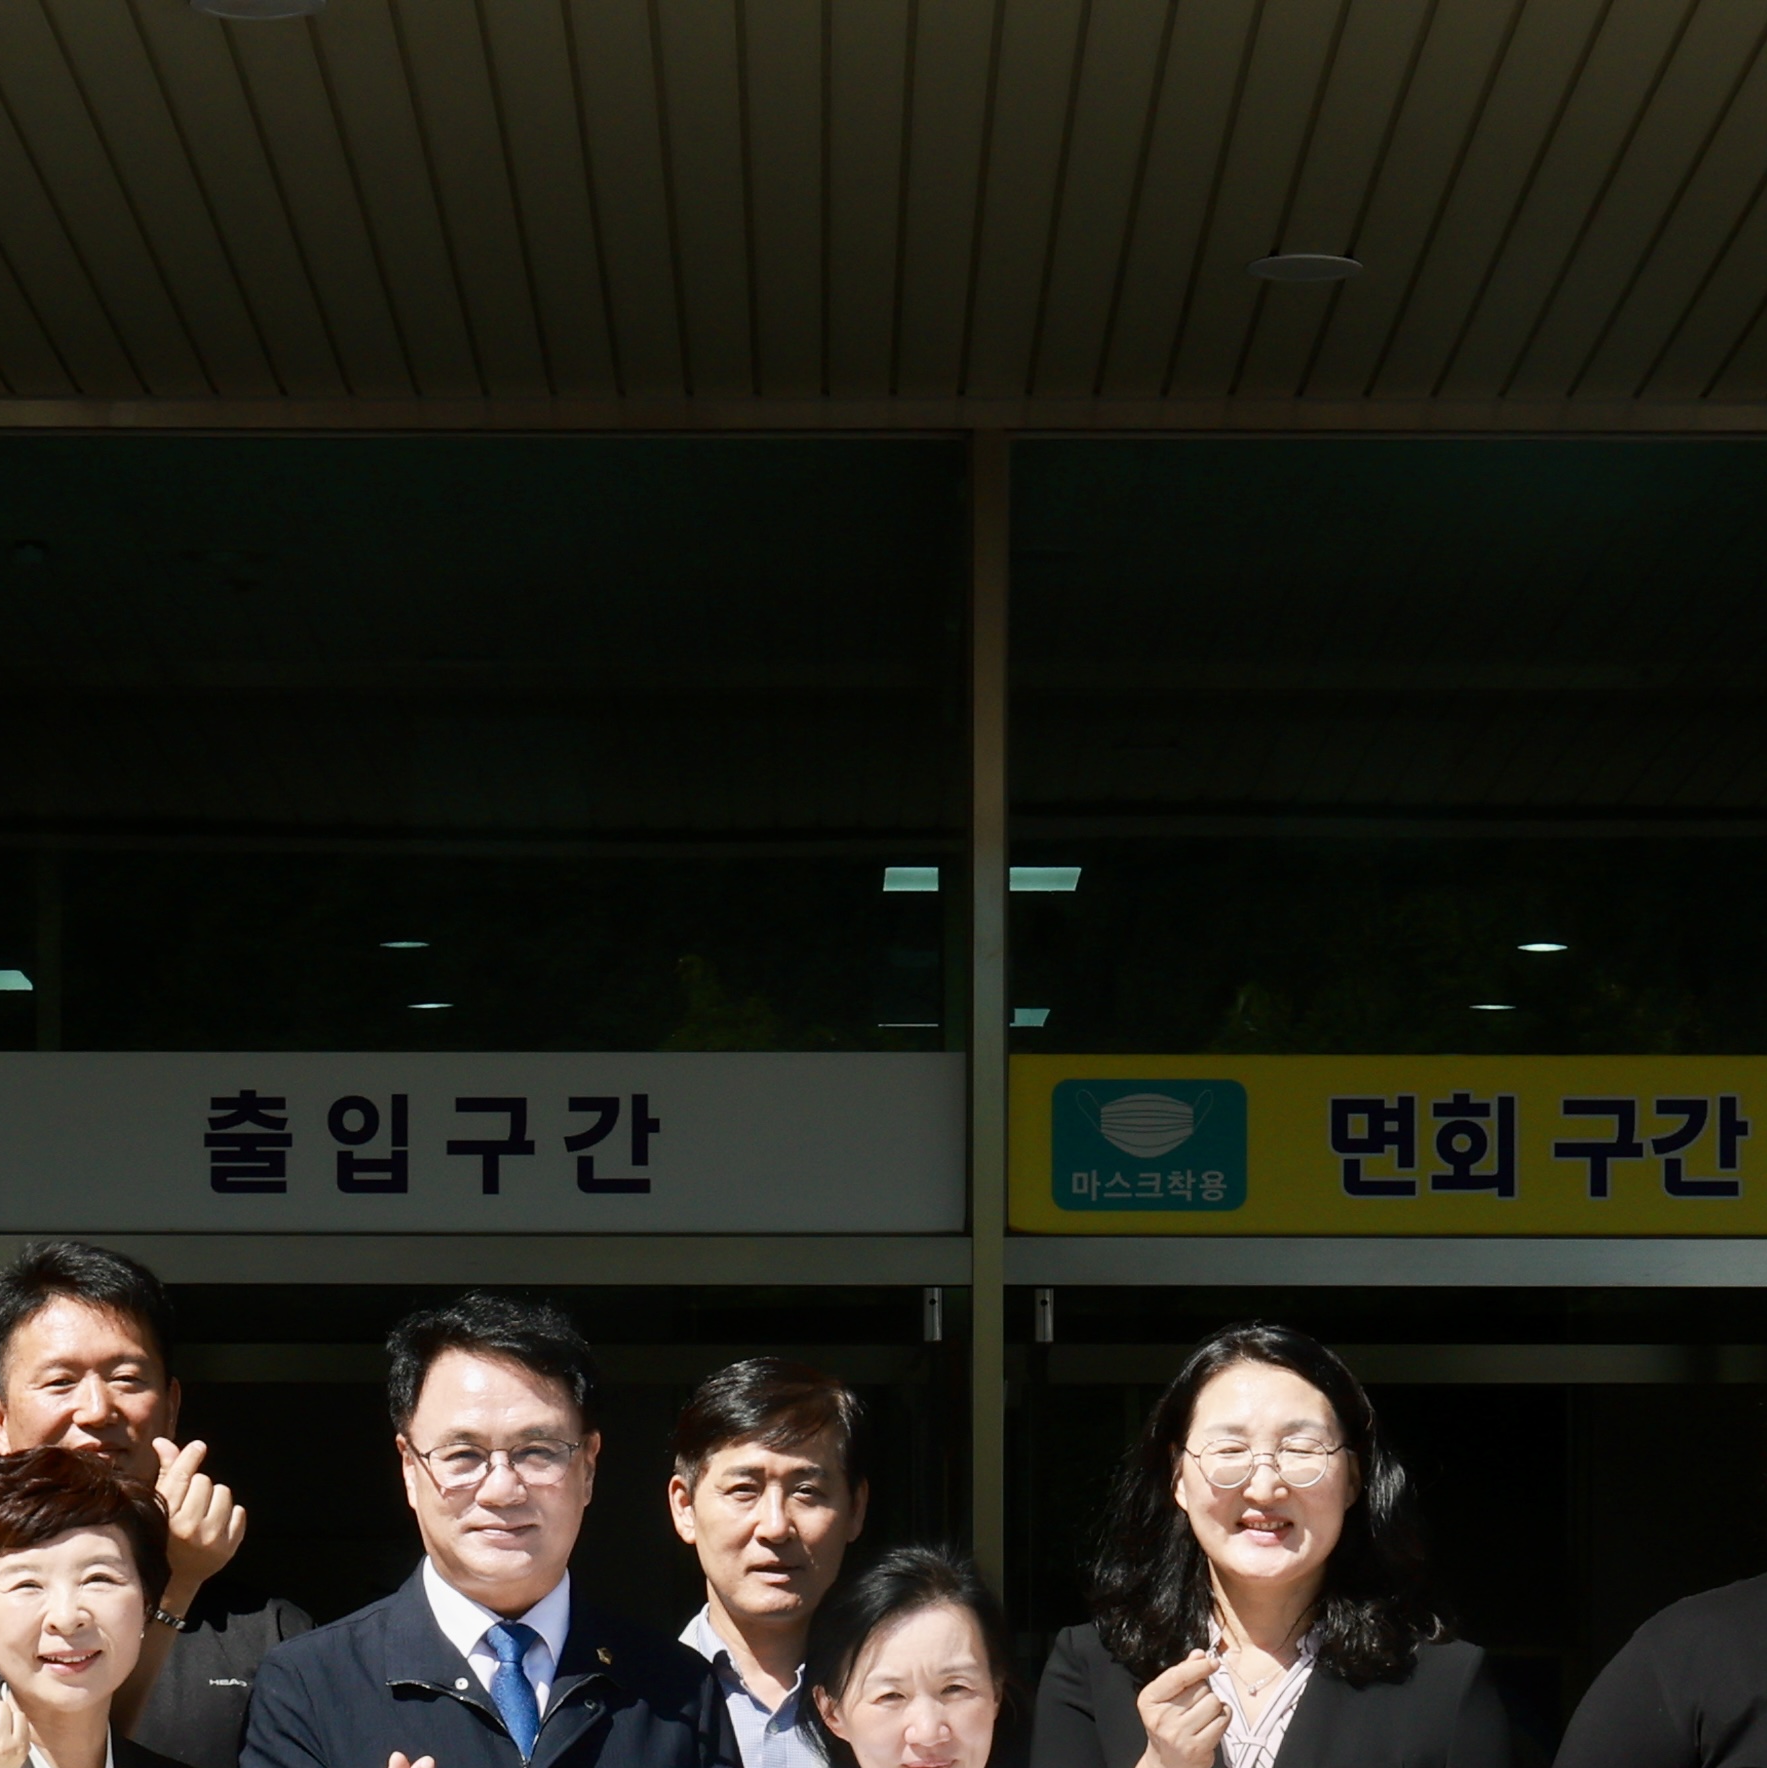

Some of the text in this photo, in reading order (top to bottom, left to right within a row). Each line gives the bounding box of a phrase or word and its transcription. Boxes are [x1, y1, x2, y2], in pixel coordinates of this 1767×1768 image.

[204, 1091, 661, 1195] 출입구간
[1072, 1169, 1228, 1202] 마스크착용
[1328, 1091, 1752, 1198] 면회 구간
